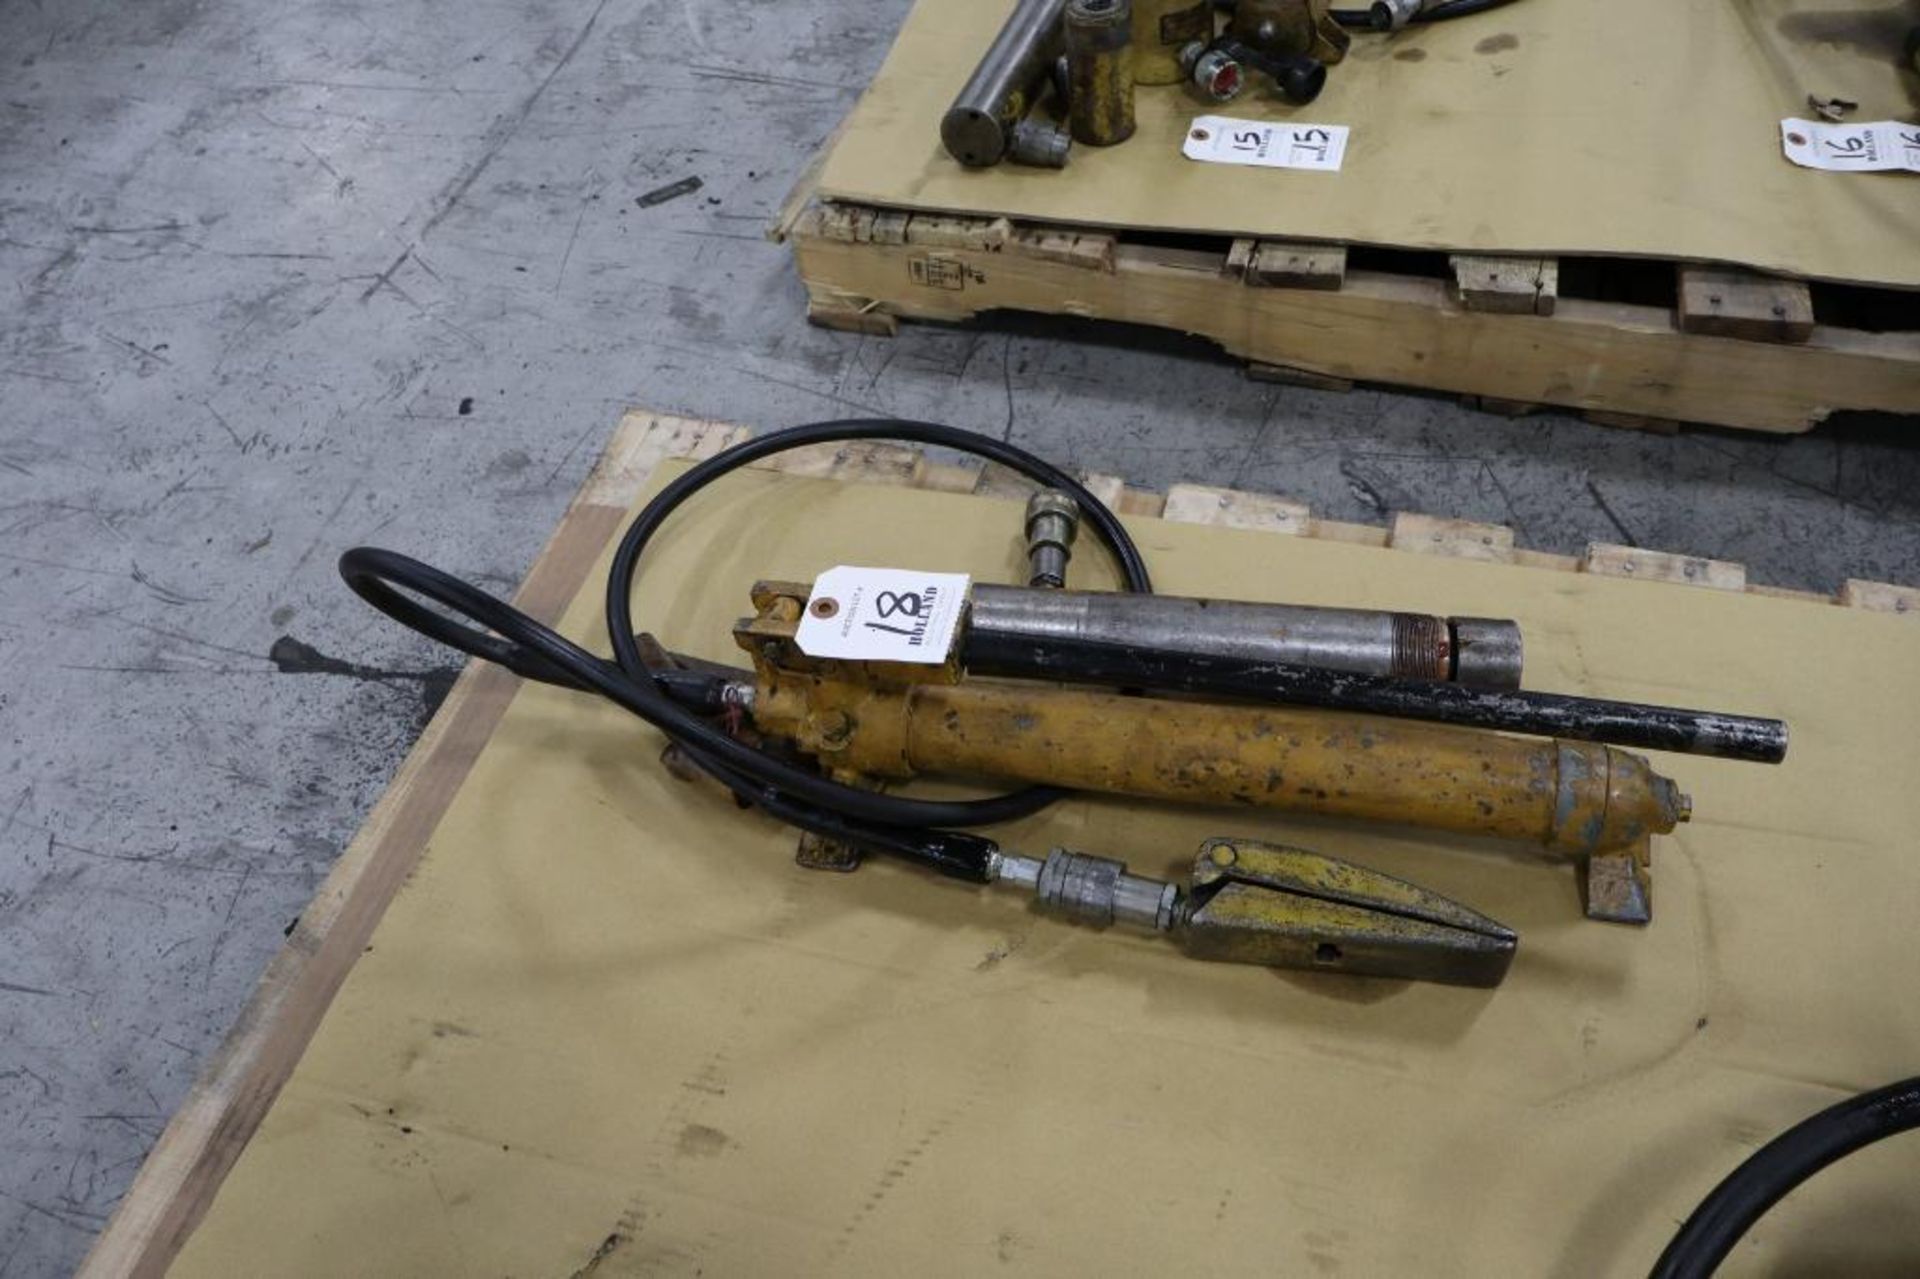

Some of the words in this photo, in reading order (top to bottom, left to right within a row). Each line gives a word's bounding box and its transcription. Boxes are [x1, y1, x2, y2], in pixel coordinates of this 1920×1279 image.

[1232, 131, 1261, 151] 15
[1293, 128, 1330, 151] 15
[1825, 137, 1865, 159] 16
[864, 590, 922, 636] 18
